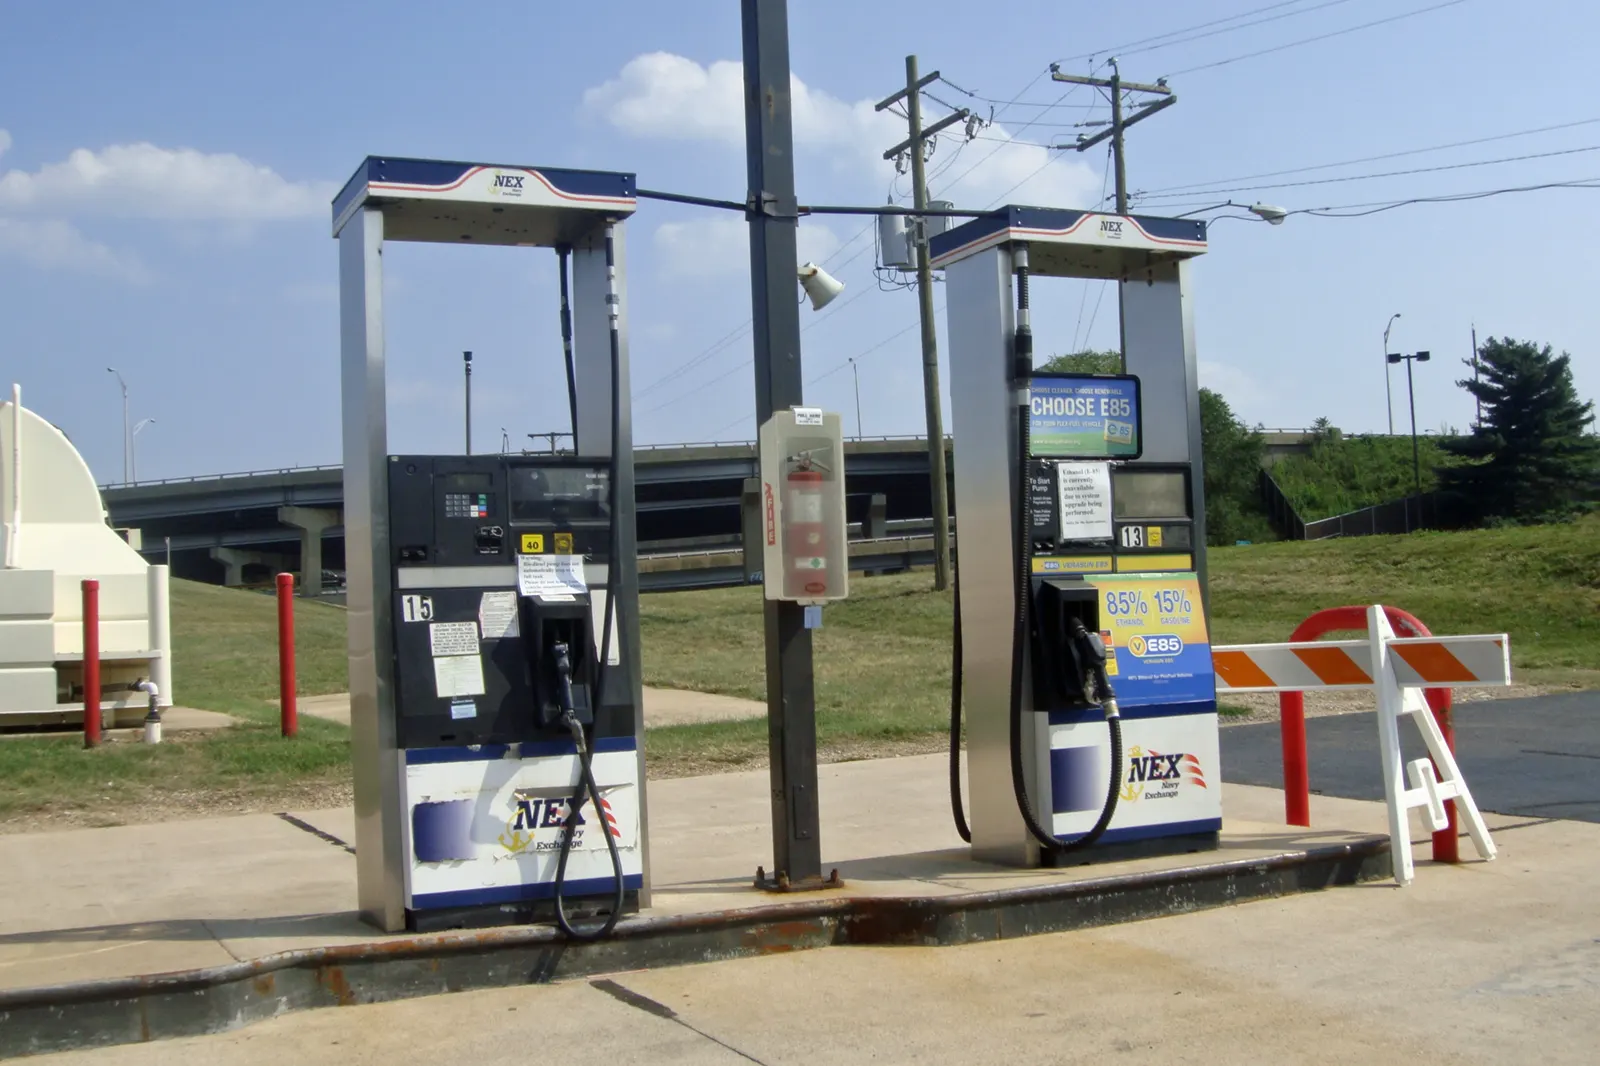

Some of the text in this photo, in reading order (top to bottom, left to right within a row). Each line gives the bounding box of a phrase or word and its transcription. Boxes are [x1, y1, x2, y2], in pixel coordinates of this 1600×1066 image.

[493, 175, 525, 188] NEX
[1100, 220, 1123, 232] NEX
[1031, 397, 1130, 416] CHOOSE E85
[1120, 426, 1129, 436] 85
[766, 498, 774, 542] FIRE
[1124, 527, 1141, 546] 13
[406, 596, 432, 620] 15
[1106, 589, 1191, 615] 85% 15%
[1116, 618, 1144, 627] ETHANOL
[1160, 617, 1190, 625] GASOLINE
[1133, 638, 1179, 652] V E85
[1128, 754, 1184, 783] NEX
[1145, 791, 1178, 799] Exchange
[560, 830, 584, 838] Nvy
